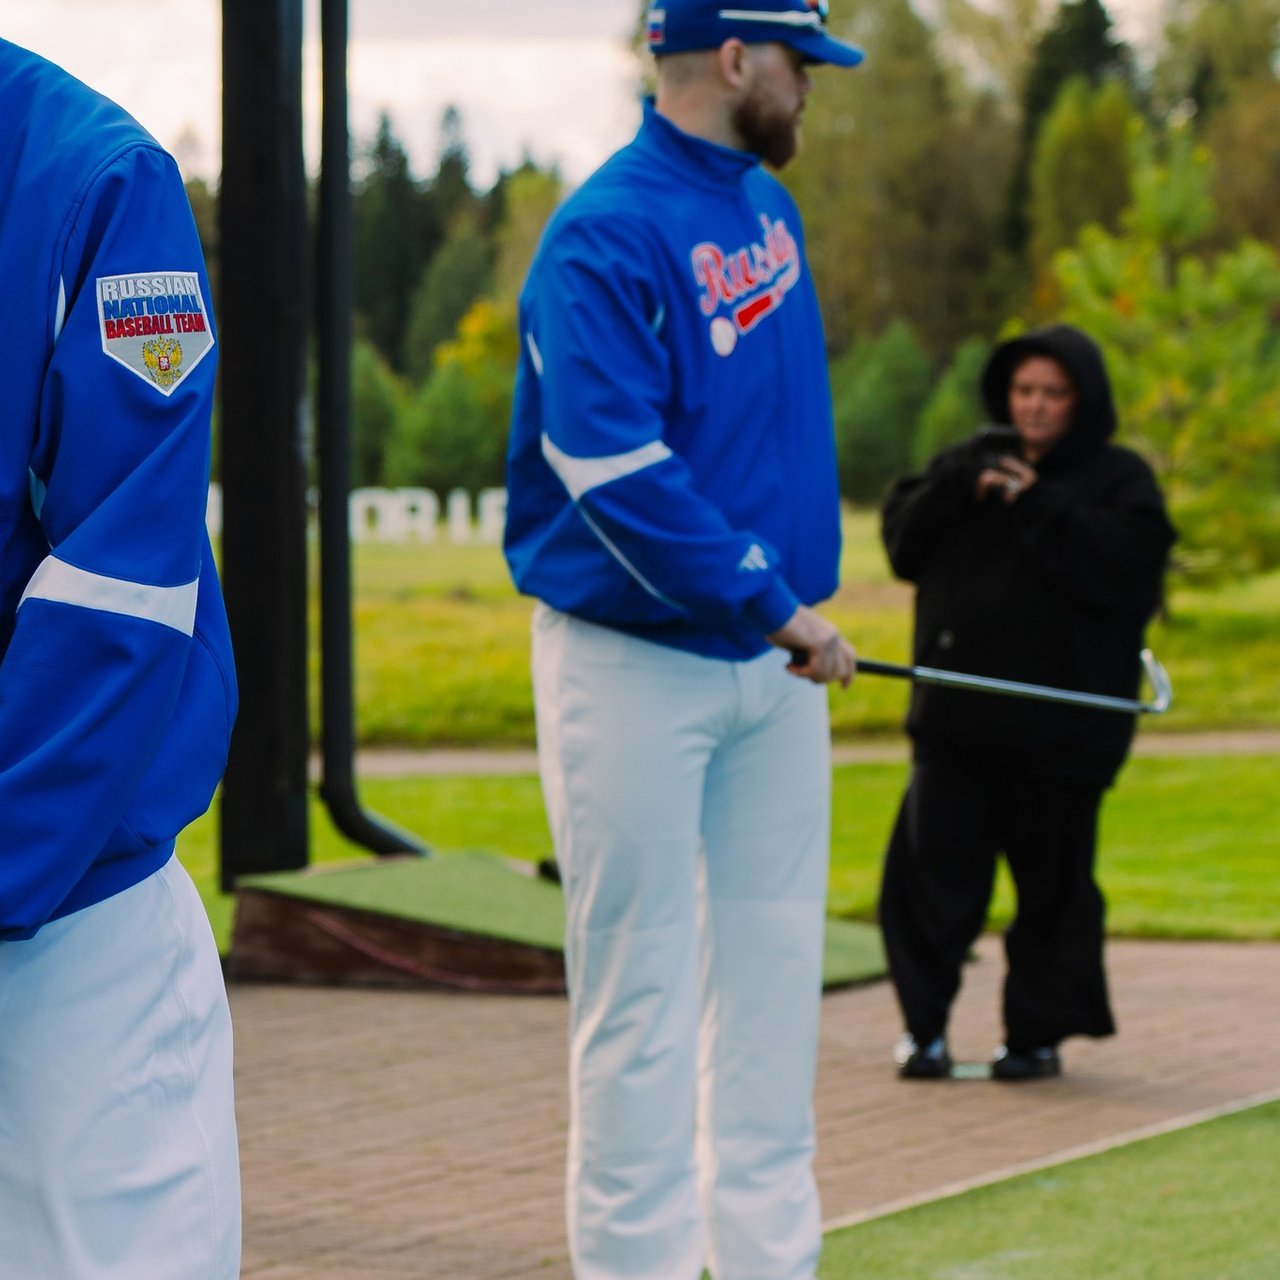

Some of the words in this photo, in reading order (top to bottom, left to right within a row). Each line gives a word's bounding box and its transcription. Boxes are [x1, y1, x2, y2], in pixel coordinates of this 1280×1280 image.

[102, 277, 197, 301] RUSSIAN
[103, 295, 202, 320] NATIONAL
[105, 315, 174, 340] BASEBALL
[173, 313, 206, 333] TEAM
